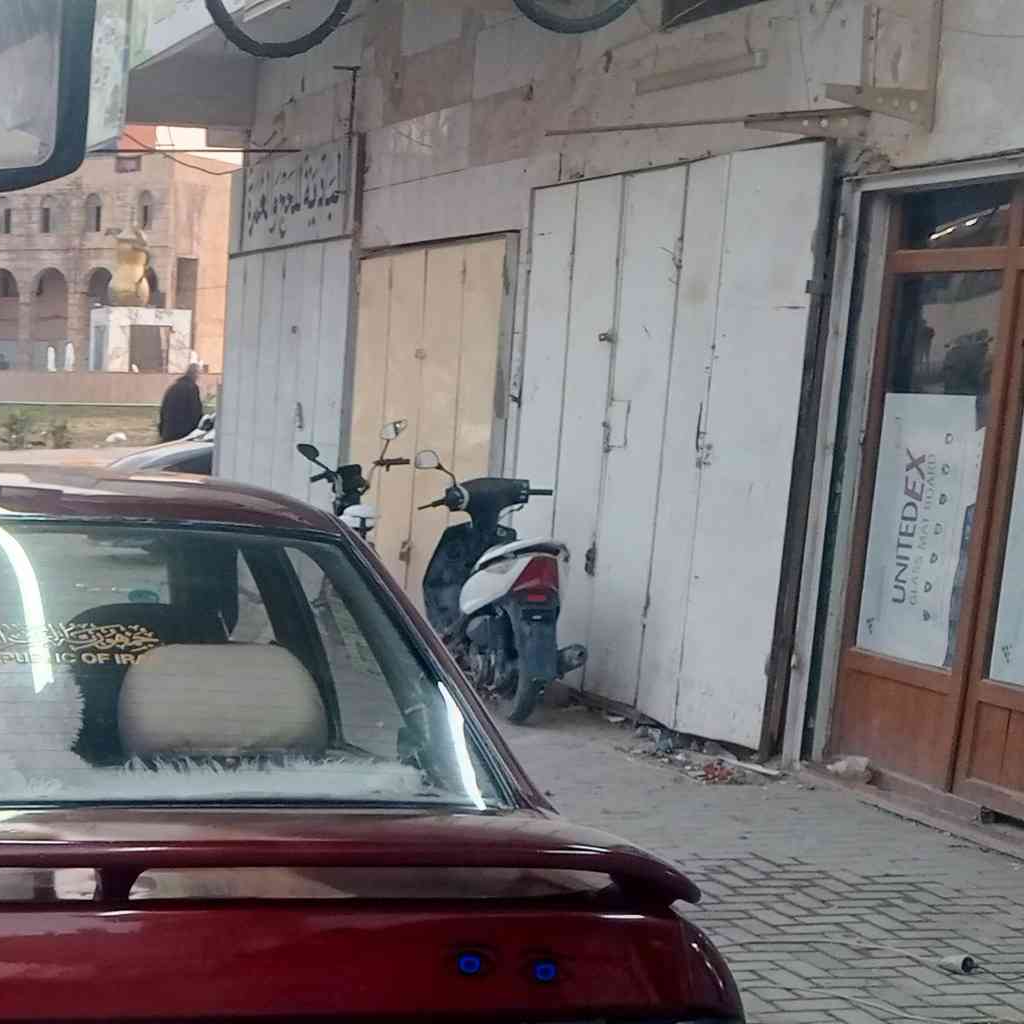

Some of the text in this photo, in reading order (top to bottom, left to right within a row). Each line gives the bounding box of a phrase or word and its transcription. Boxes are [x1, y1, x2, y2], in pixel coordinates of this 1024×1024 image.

[892, 448, 926, 604] UNITEDEX
[81, 652, 110, 664] OF
[114, 652, 141, 664] IR
